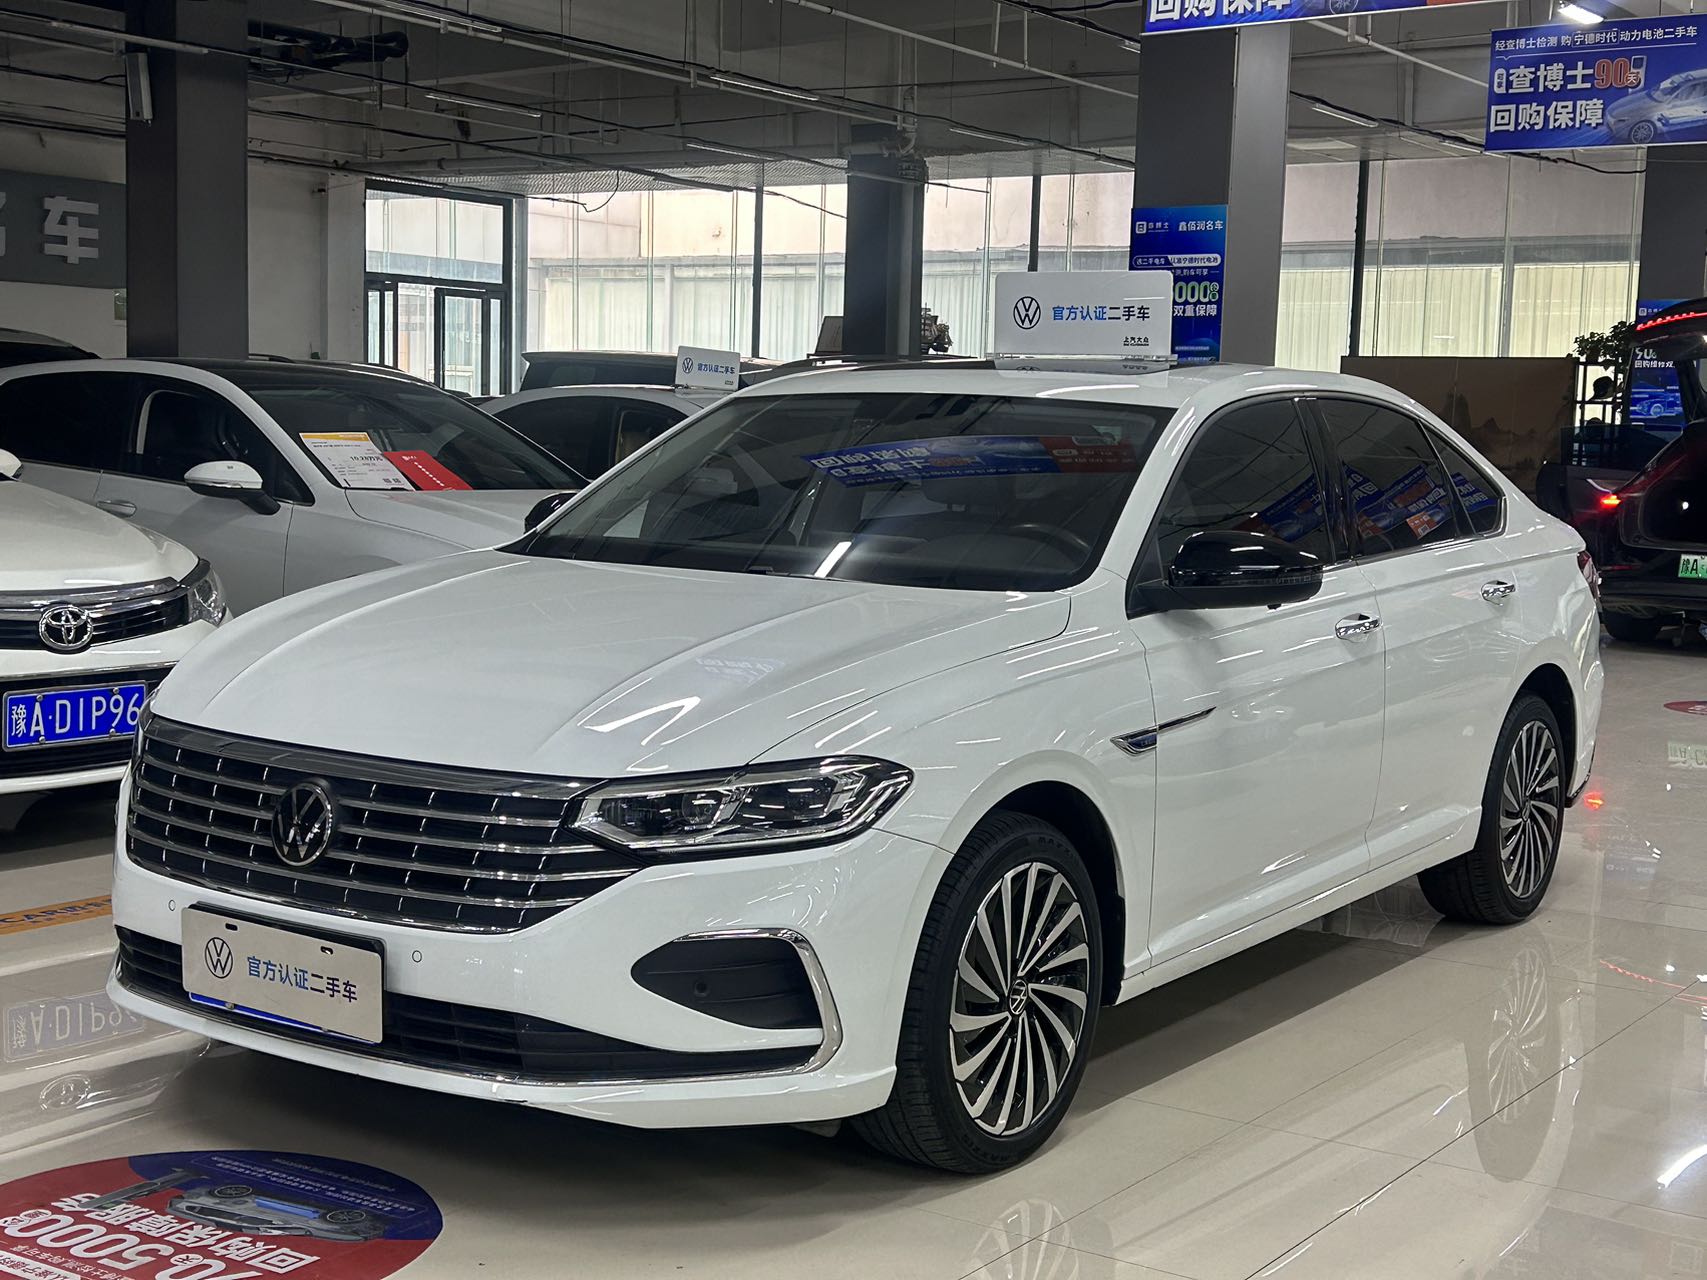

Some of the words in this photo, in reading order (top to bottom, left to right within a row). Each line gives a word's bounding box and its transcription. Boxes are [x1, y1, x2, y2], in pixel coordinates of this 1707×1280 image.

[1490, 98, 1604, 132] 回购保障
[1052, 304, 1150, 322] 官方认证二手车
[1173, 304, 1218, 317] 双重保障
[246, 955, 358, 1003] 官方认证二手车
[51, 1193, 321, 1274] 回购保障服务
